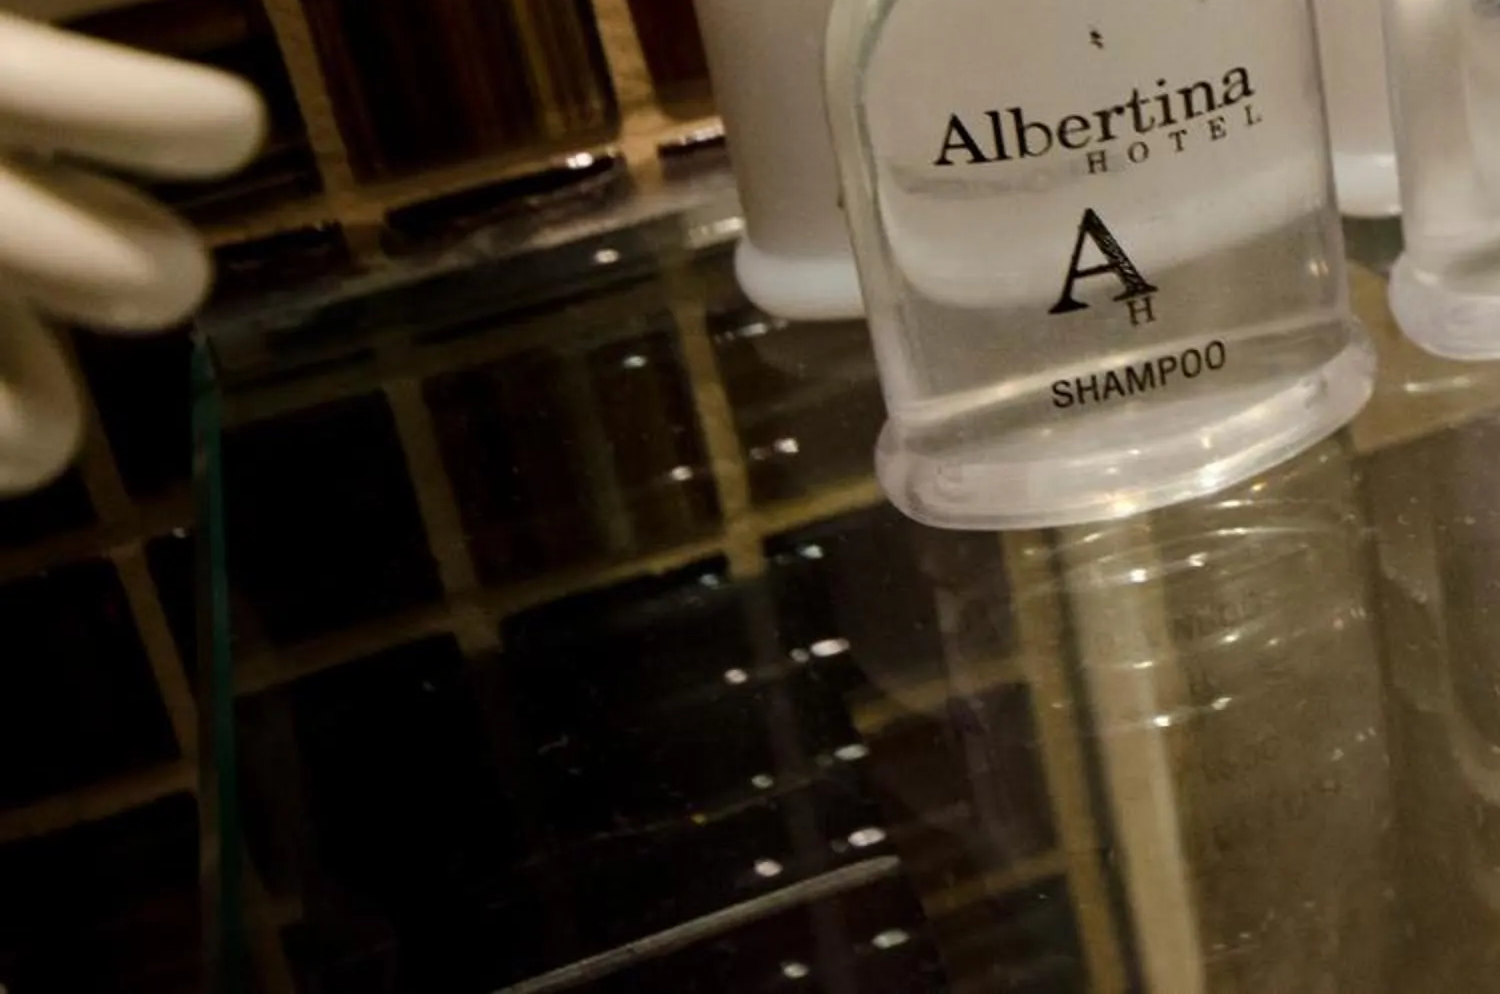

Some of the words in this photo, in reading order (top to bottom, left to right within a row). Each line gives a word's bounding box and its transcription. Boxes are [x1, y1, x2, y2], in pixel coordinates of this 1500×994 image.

[934, 65, 1255, 166] Albertina
[1087, 106, 1263, 175] HOTEL
[1047, 207, 1159, 314] A
[1050, 339, 1228, 409] SHAMPOO
